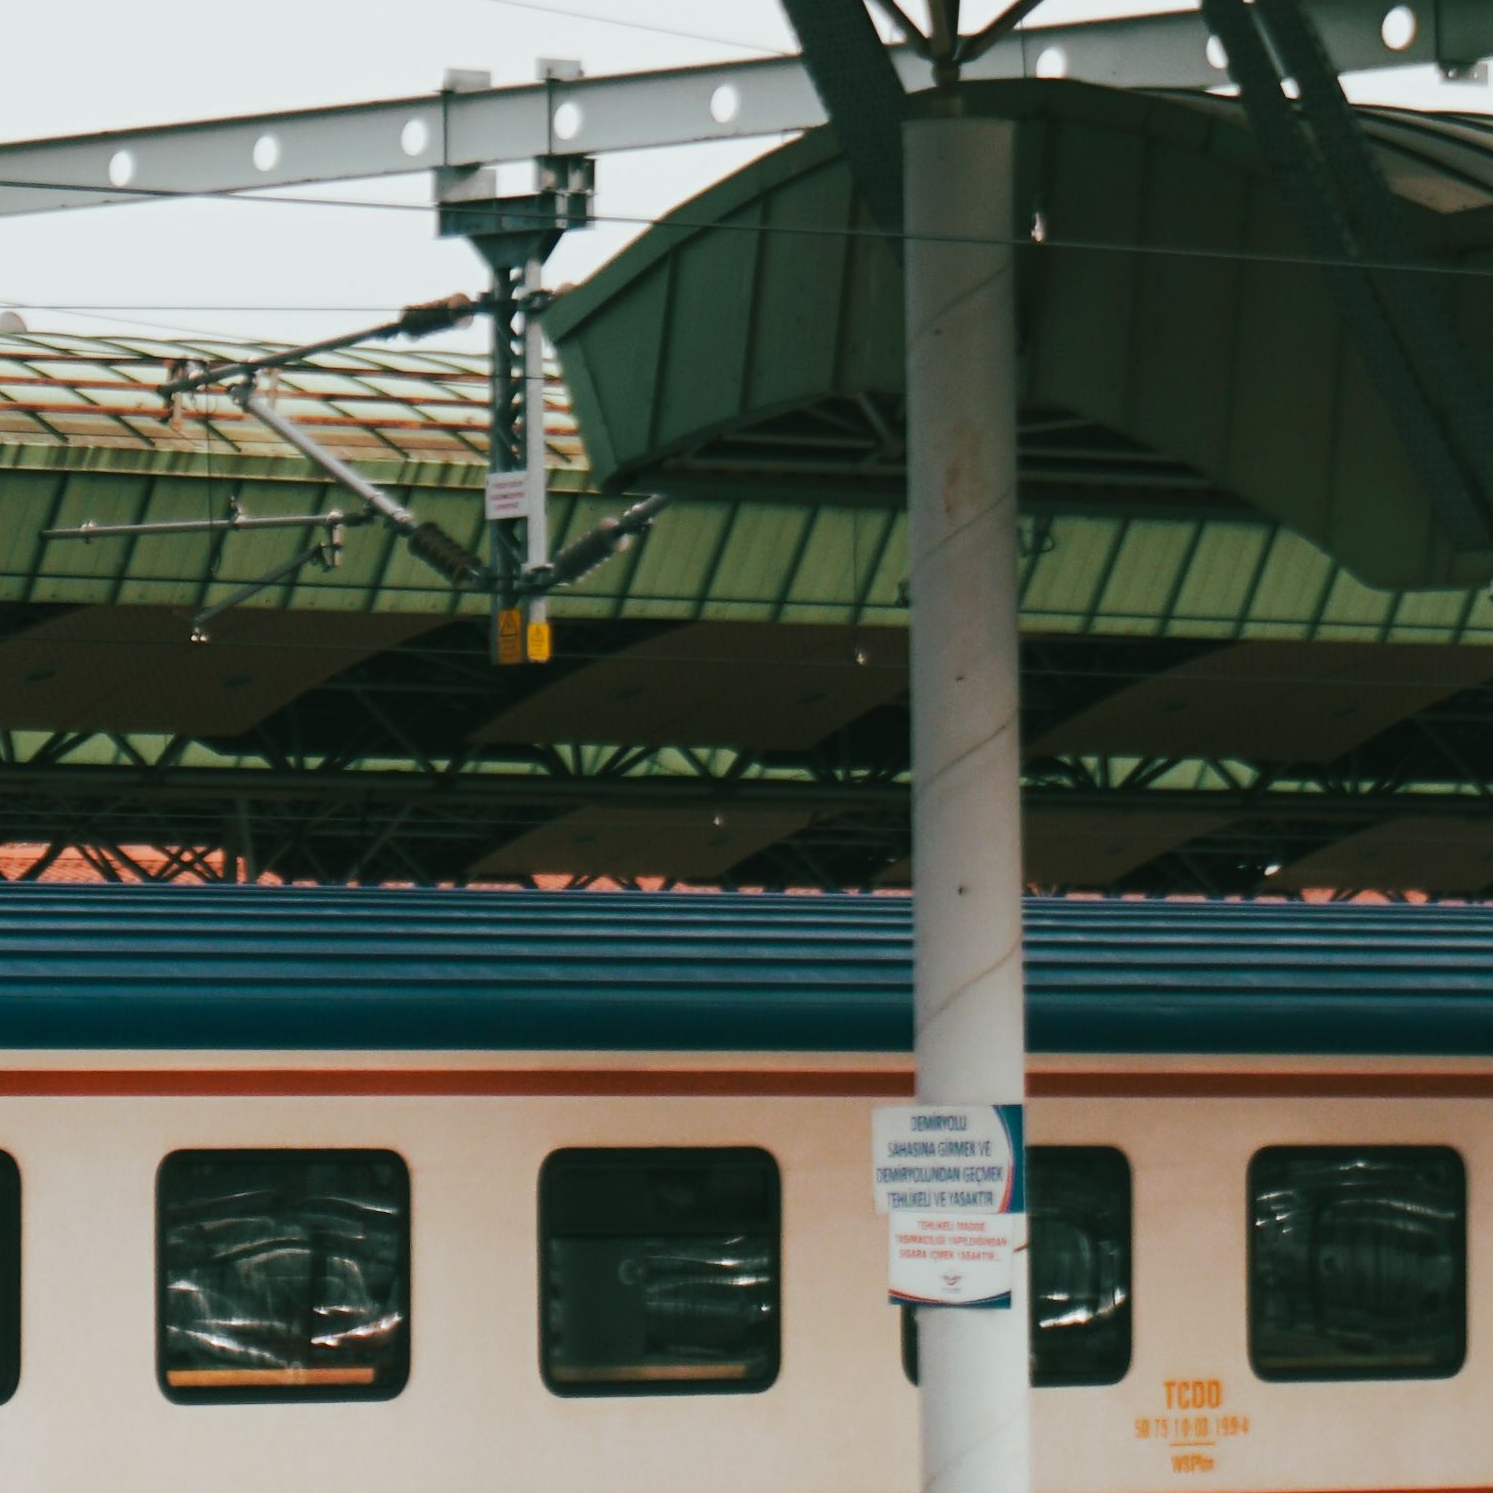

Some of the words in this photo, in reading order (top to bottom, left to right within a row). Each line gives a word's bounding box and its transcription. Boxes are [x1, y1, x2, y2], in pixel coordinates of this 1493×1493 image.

[978, 1140, 991, 1157] VE
[933, 1191, 946, 1207] VE
[1164, 1379, 1223, 1410] TCDD
